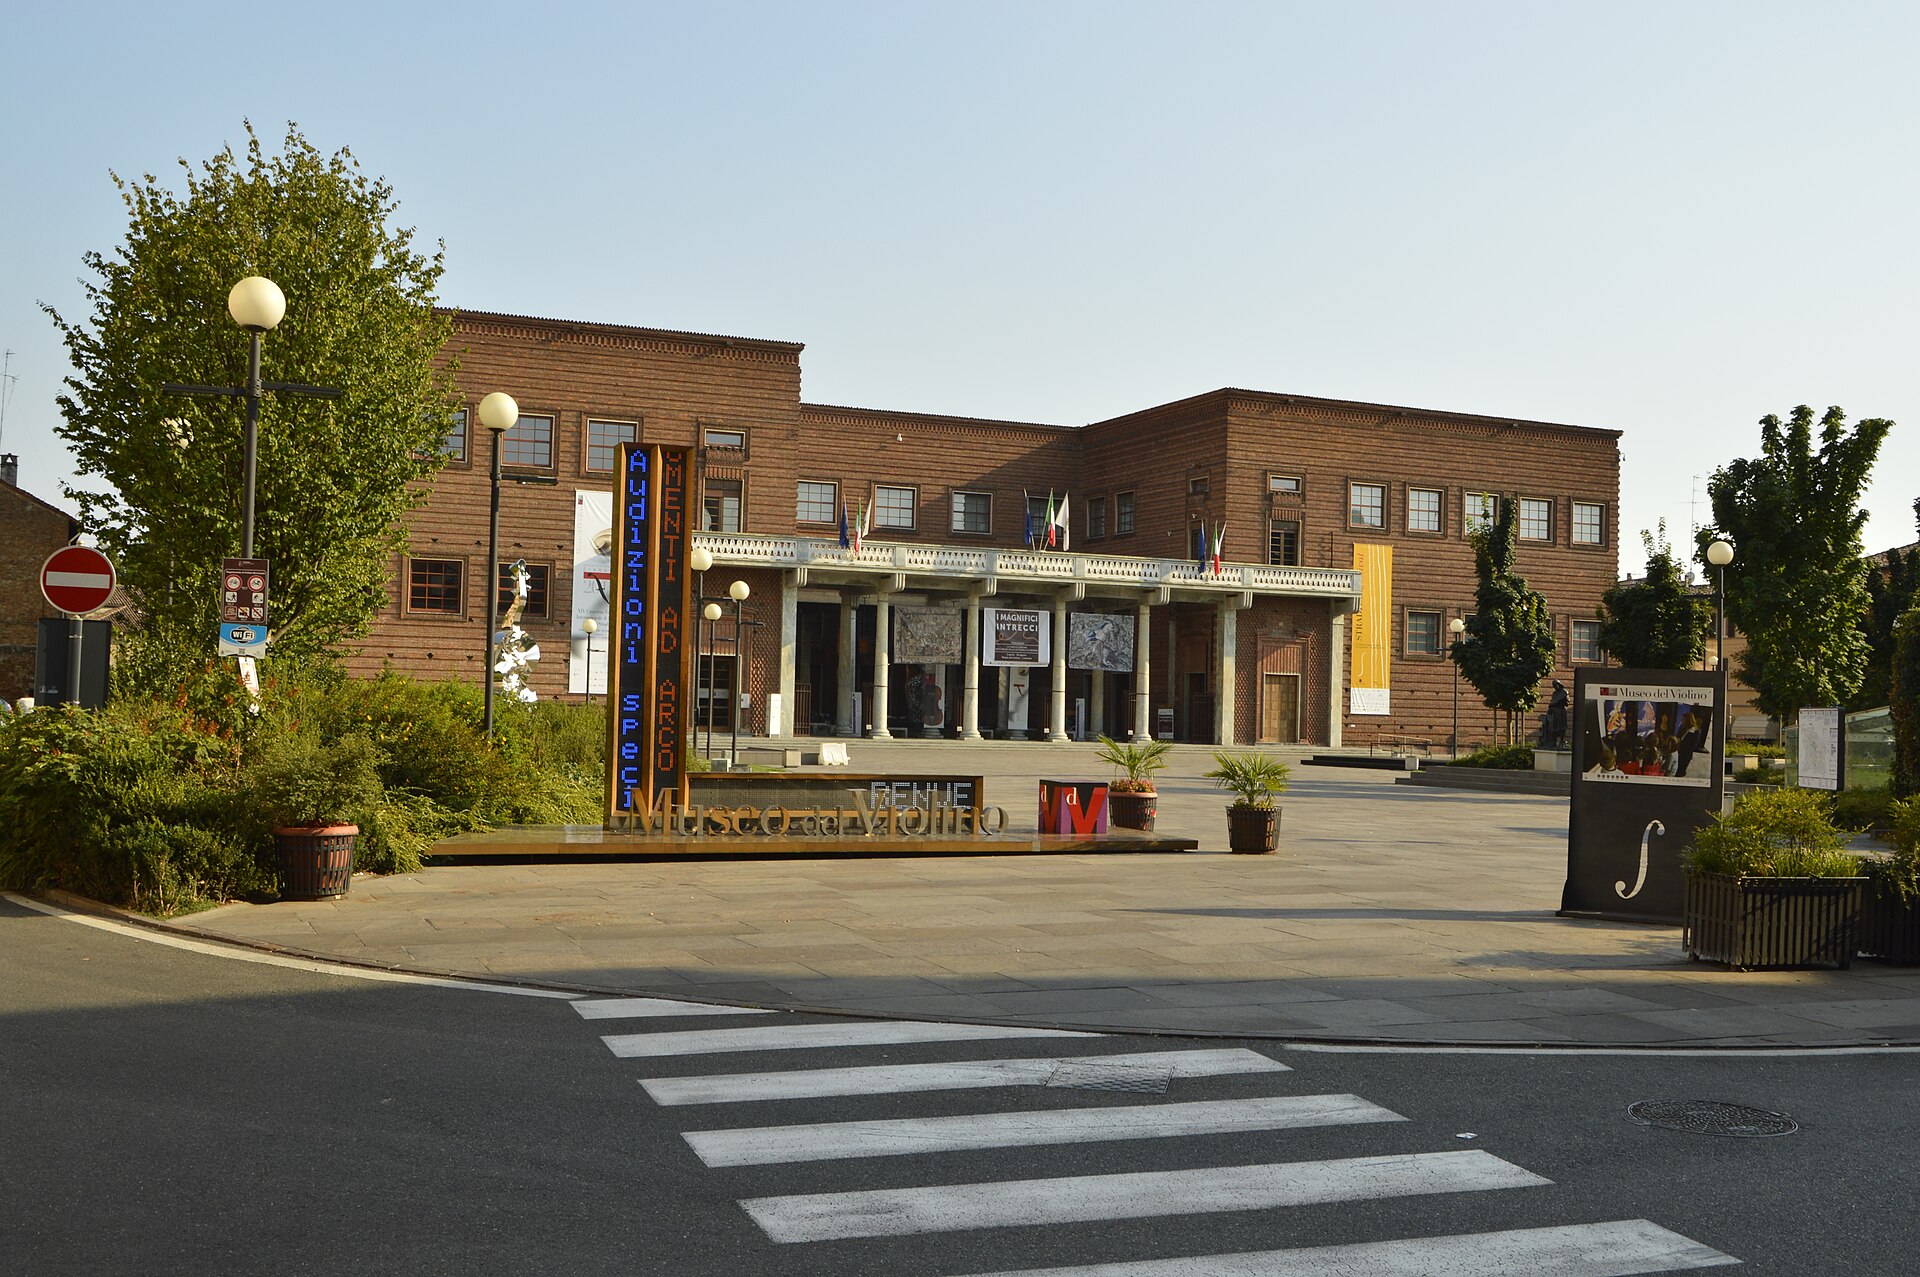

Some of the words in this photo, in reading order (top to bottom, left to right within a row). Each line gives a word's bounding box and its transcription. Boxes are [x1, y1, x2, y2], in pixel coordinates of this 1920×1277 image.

[625, 449, 647, 663] Audizioni
[661, 606, 678, 653] AD
[996, 623, 1038, 632] INTRECCI
[1000, 613, 1038, 622] MAGNIFICI
[1619, 686, 1652, 698] Museo
[1653, 688, 1669, 699] del
[1670, 689, 1708, 701] Violino
[658, 679, 676, 772] ARCO
[623, 787, 791, 837] Museo
[800, 804, 845, 837] del
[846, 788, 1010, 837] Violino
